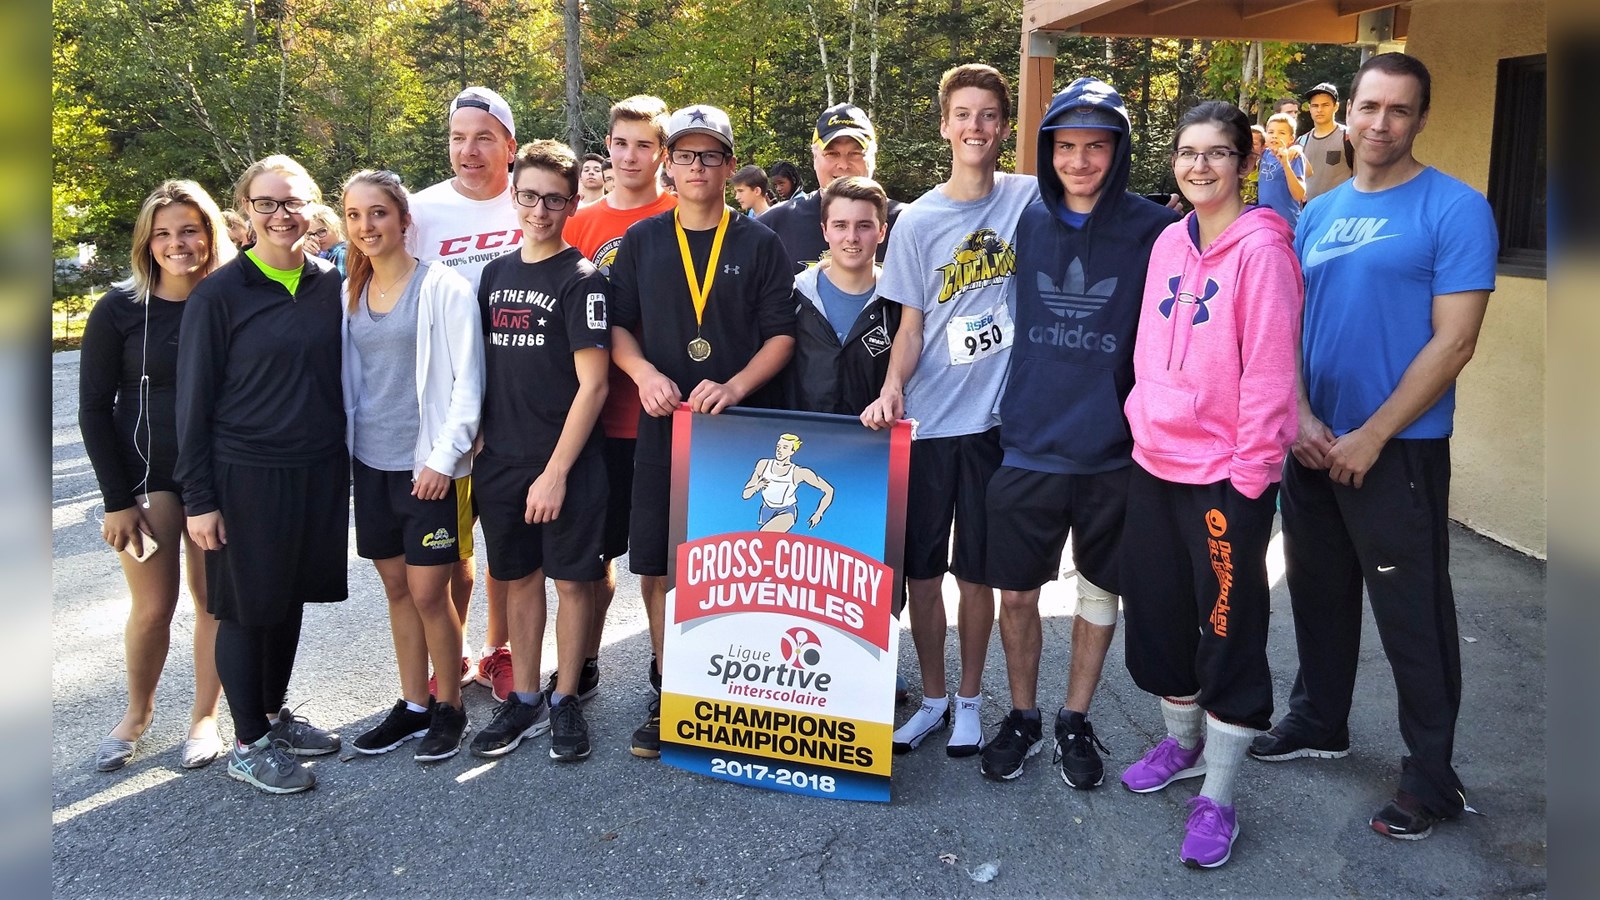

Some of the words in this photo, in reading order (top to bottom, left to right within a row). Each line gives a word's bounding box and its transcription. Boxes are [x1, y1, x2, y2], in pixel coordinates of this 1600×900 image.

[1319, 217, 1389, 244] RUN
[503, 289, 525, 303] THE
[525, 290, 557, 313] WALL
[492, 307, 533, 330] VANS
[511, 333, 545, 347] 1966
[964, 324, 1003, 356] 950
[1028, 322, 1117, 353] adidas
[687, 538, 883, 607] CROSS-COUNTRY
[699, 577, 865, 630] JUVÉNILES
[728, 644, 771, 663] Ligue
[707, 654, 832, 692] Sportive
[728, 681, 827, 708] interscolaire
[694, 701, 856, 743] CHAMPIONS
[676, 720, 873, 768] CHAMPIONNES
[710, 758, 836, 793] 2017-2018
